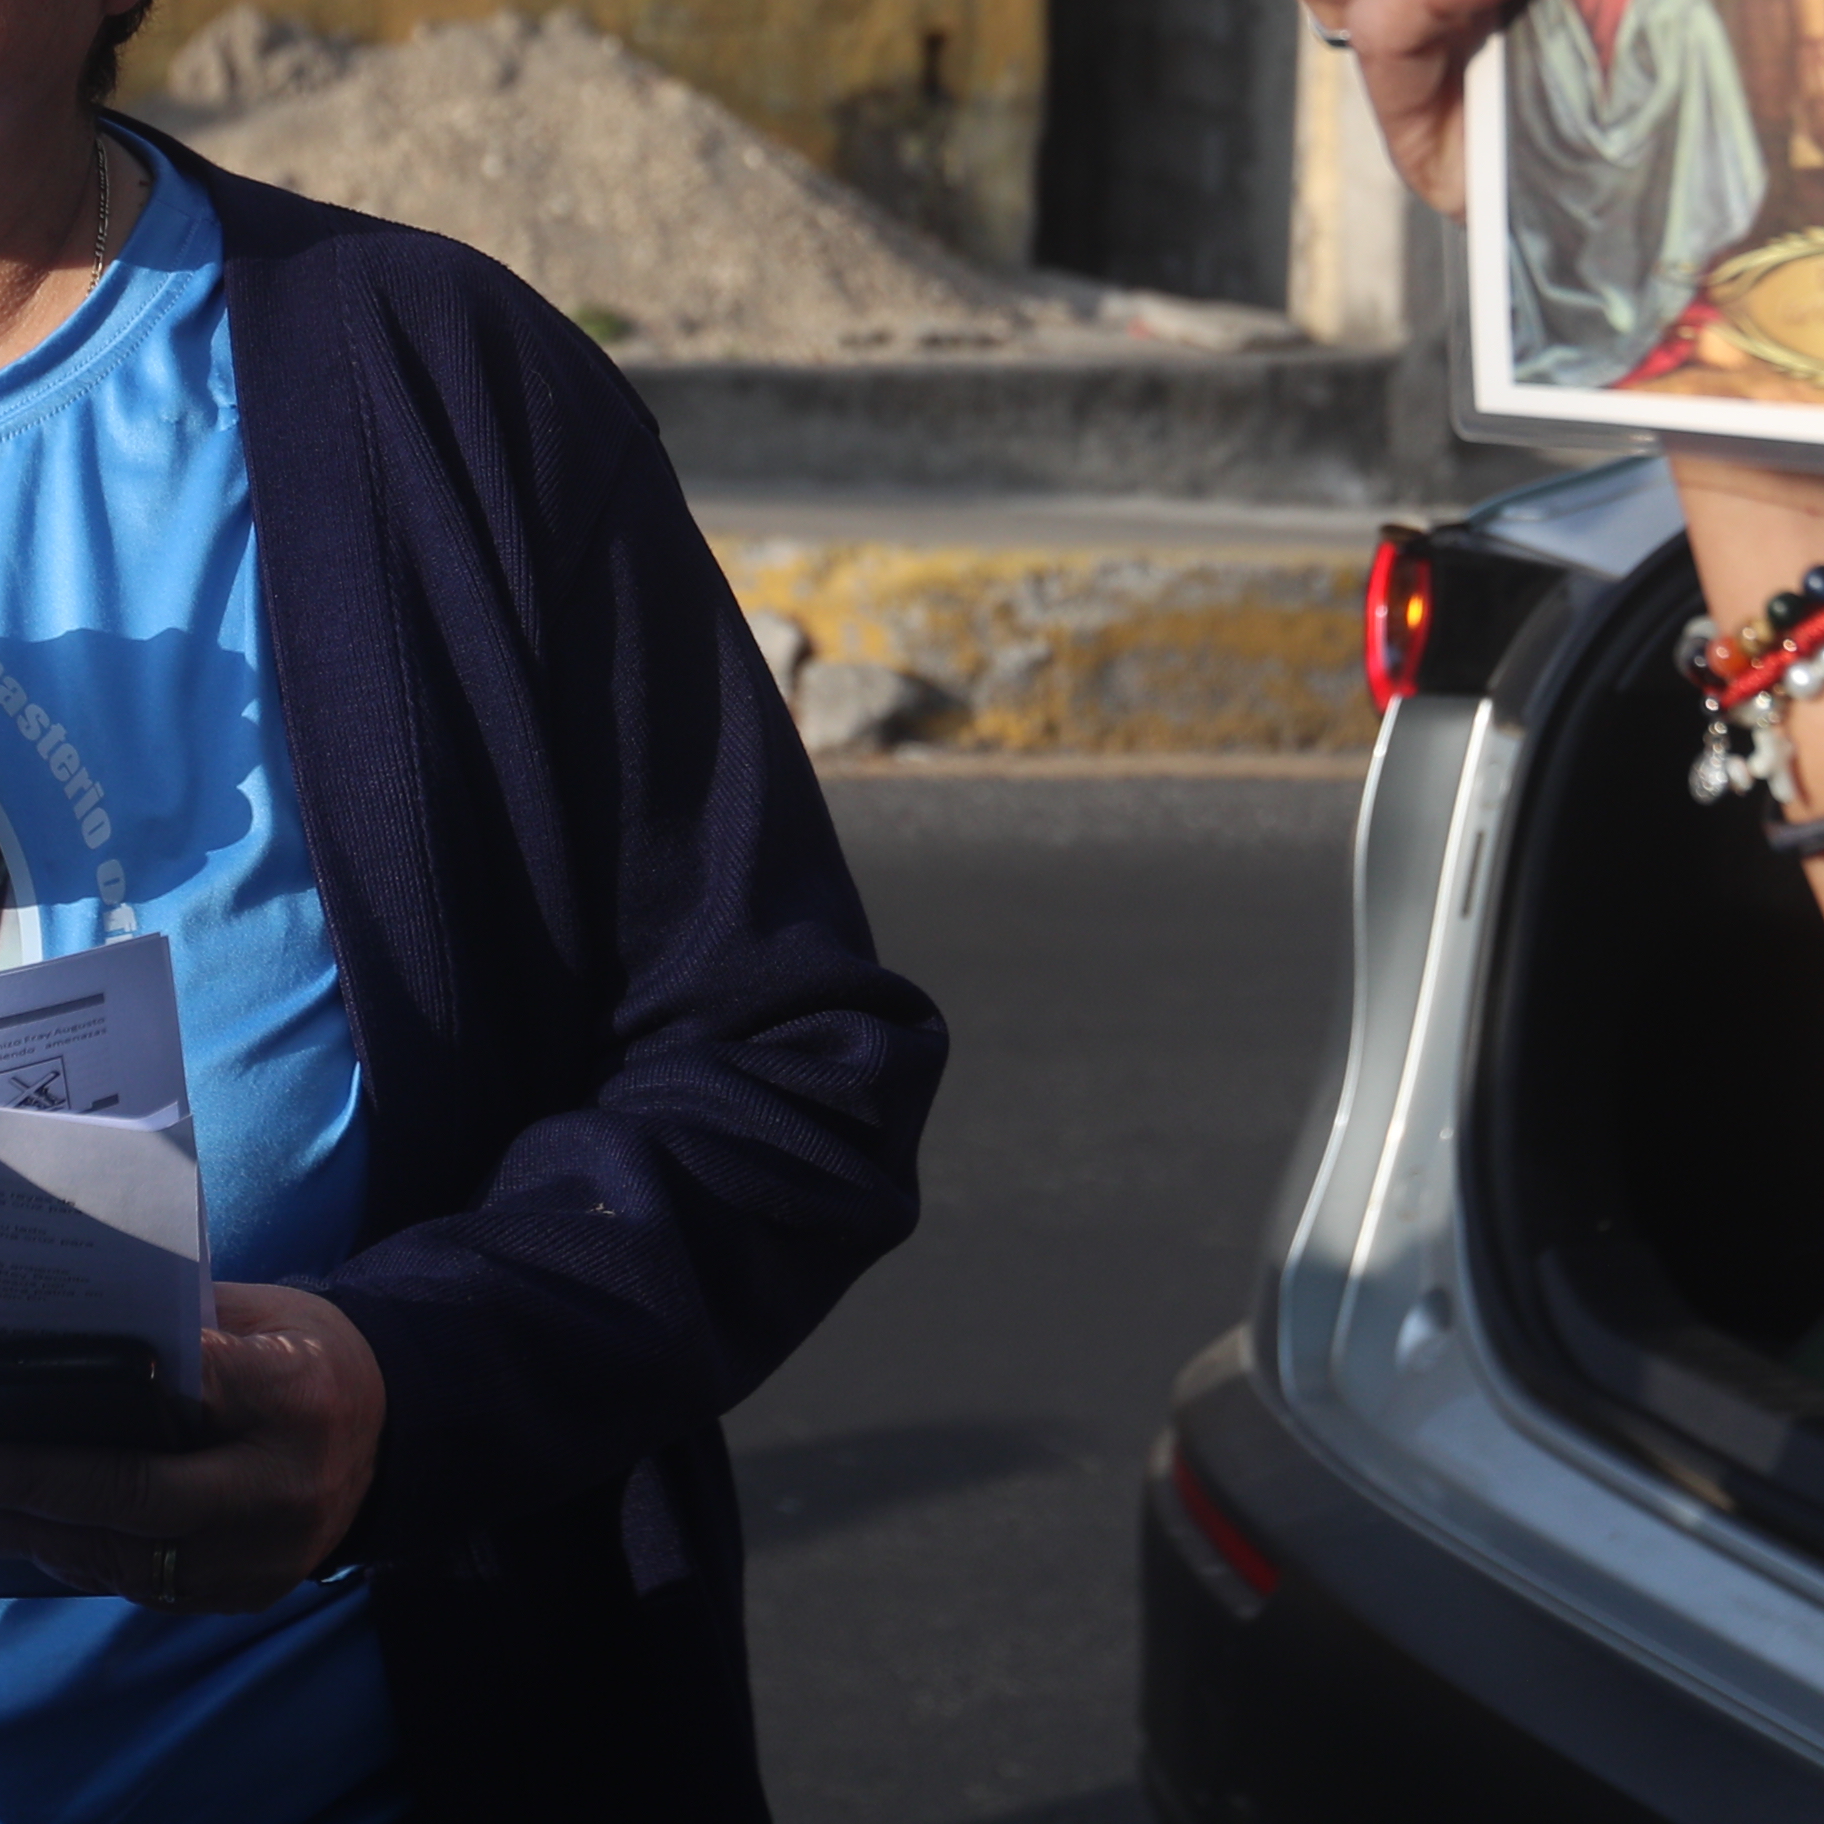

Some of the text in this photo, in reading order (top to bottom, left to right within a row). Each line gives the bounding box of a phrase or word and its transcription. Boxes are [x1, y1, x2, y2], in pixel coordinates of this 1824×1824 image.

[24, 1030, 52, 1043] Fray
[54, 1017, 105, 1036] Augusto
[45, 1028, 107, 1050] amenazas
